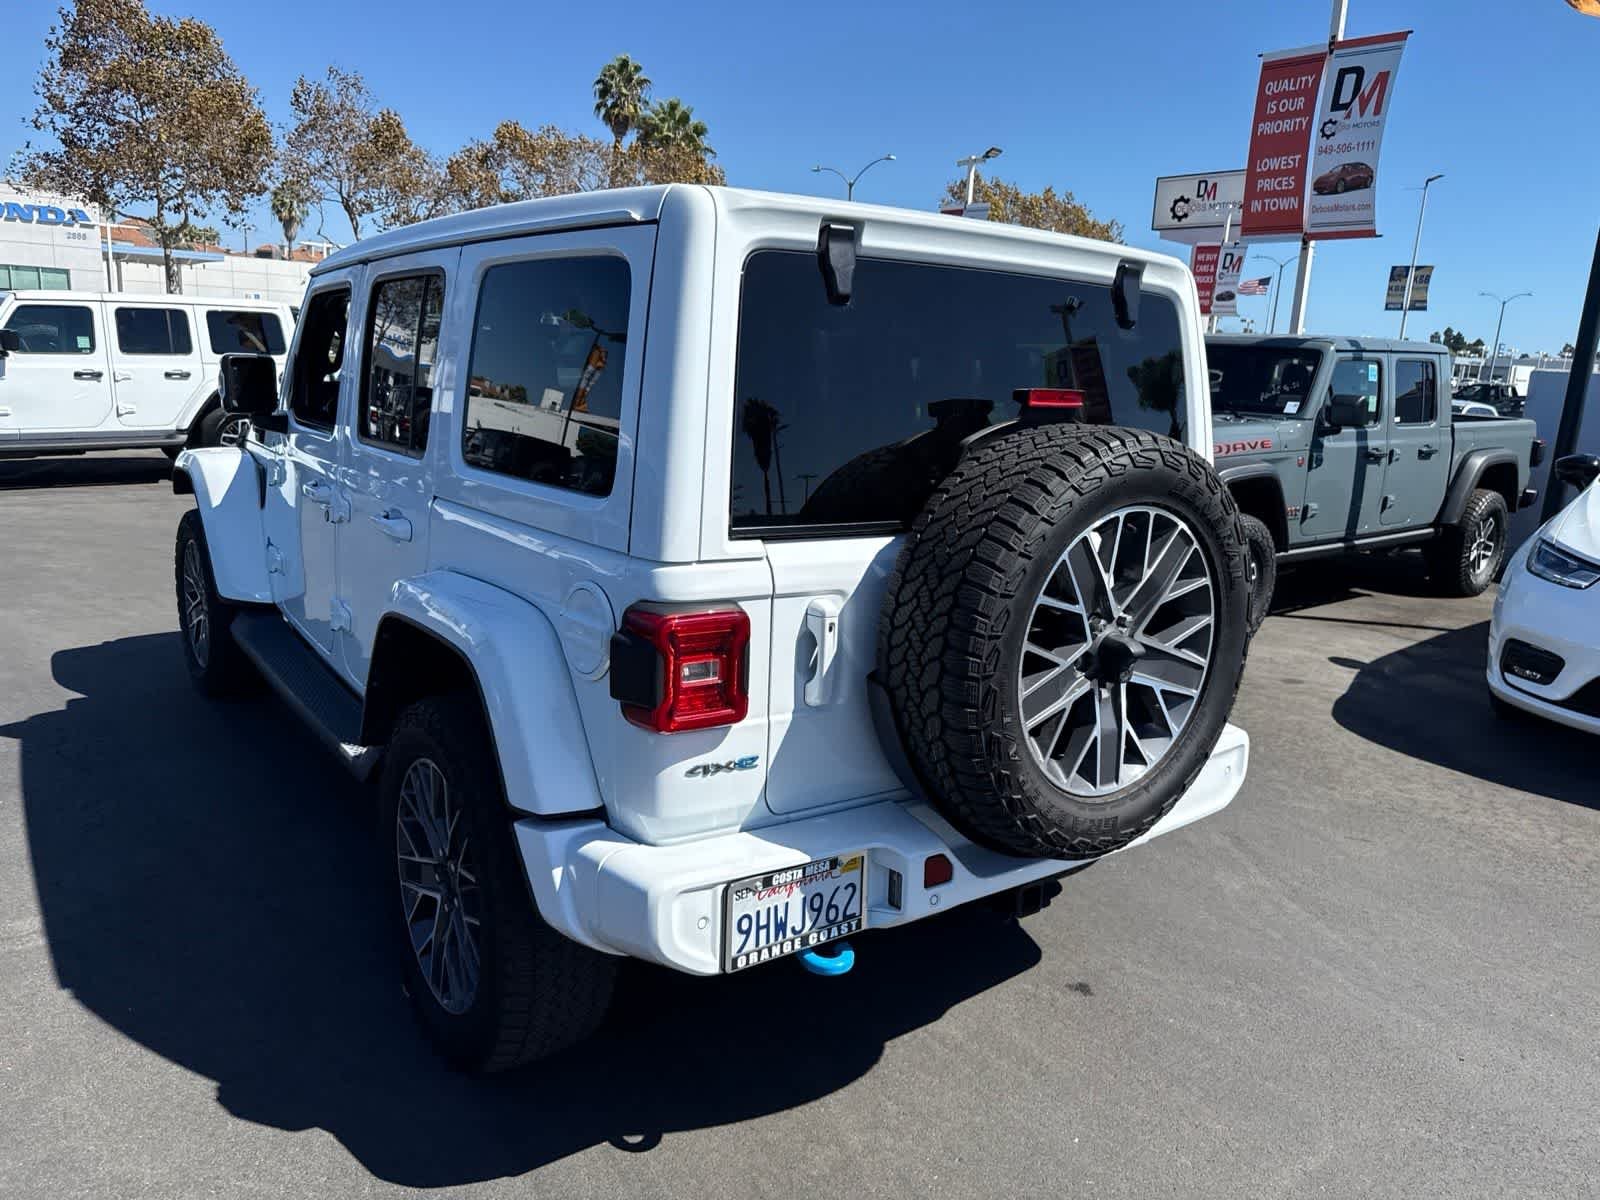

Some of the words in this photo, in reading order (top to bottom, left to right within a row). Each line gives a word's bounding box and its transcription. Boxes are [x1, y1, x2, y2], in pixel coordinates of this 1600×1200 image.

[1265, 74, 1316, 96] QUALITY
[1266, 100, 1277, 115] IS
[1279, 97, 1305, 113] OUR
[1257, 116, 1310, 136] PRIORITY
[1318, 141, 1376, 156] 949-506-1111
[1256, 155, 1302, 172] LOWEST
[1256, 176, 1295, 192] PRICES
[0, 202, 92, 226] NDA
[1250, 200, 1262, 213] IN
[1264, 197, 1299, 212] TOWN
[1213, 439, 1273, 455] OJAVE
[772, 868, 803, 886] COSTA
[804, 860, 831, 876] MESA
[736, 882, 858, 954] 9HWJ962
[737, 937, 802, 968] ORANGE
[808, 919, 858, 945] COAST
